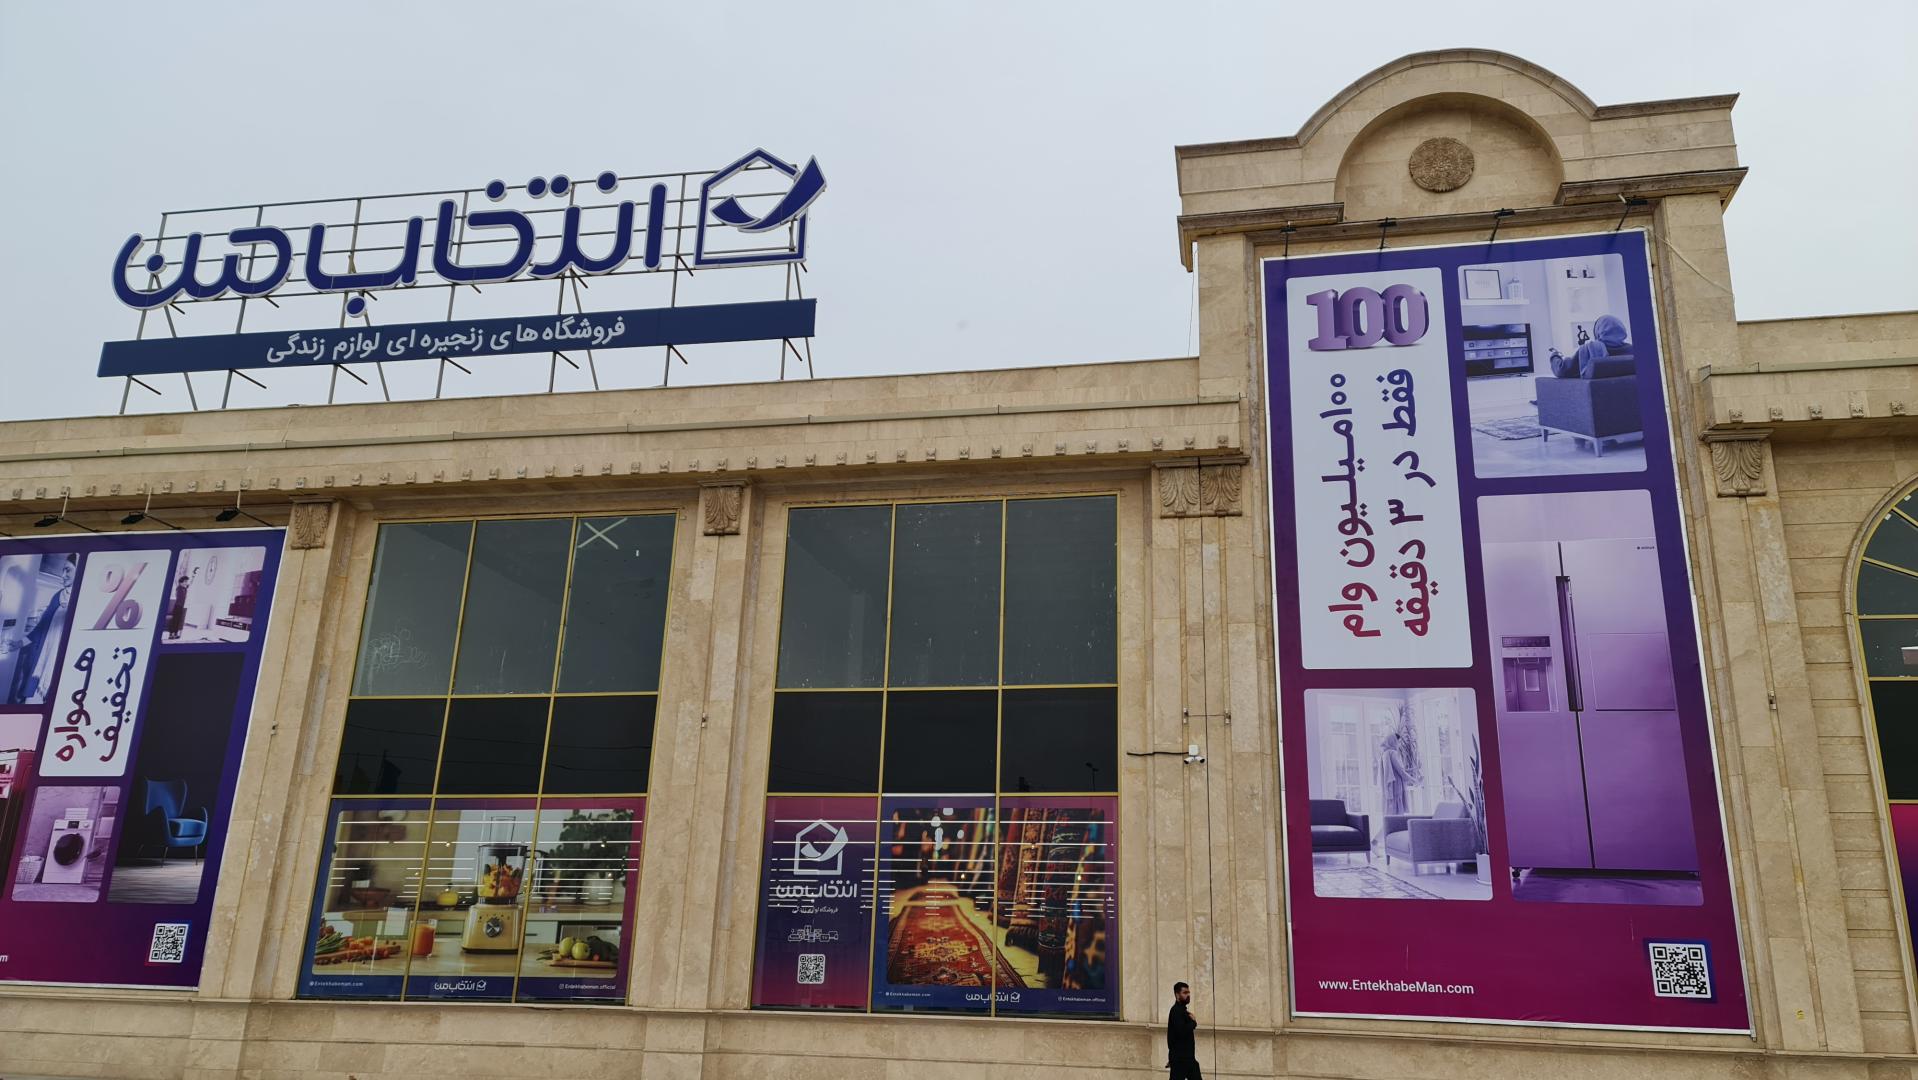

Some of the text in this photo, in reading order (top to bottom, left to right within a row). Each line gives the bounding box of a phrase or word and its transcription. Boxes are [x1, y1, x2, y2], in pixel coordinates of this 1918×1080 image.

[111, 170, 669, 318] انتخاب من
[420, 327, 483, 354] زنجیره
[542, 316, 625, 345] فروشگاه
[1306, 283, 1430, 351] 100
[266, 333, 325, 363] زندگی
[332, 332, 380, 360] لوازم
[1375, 368, 1439, 638] فقط در ۳ دقیقه
[1328, 581, 1382, 638] وام
[54, 647, 96, 762] همواره
[95, 646, 138, 763] تخفیف
[1318, 979, 1475, 995] www.EntekhabeMan.com
